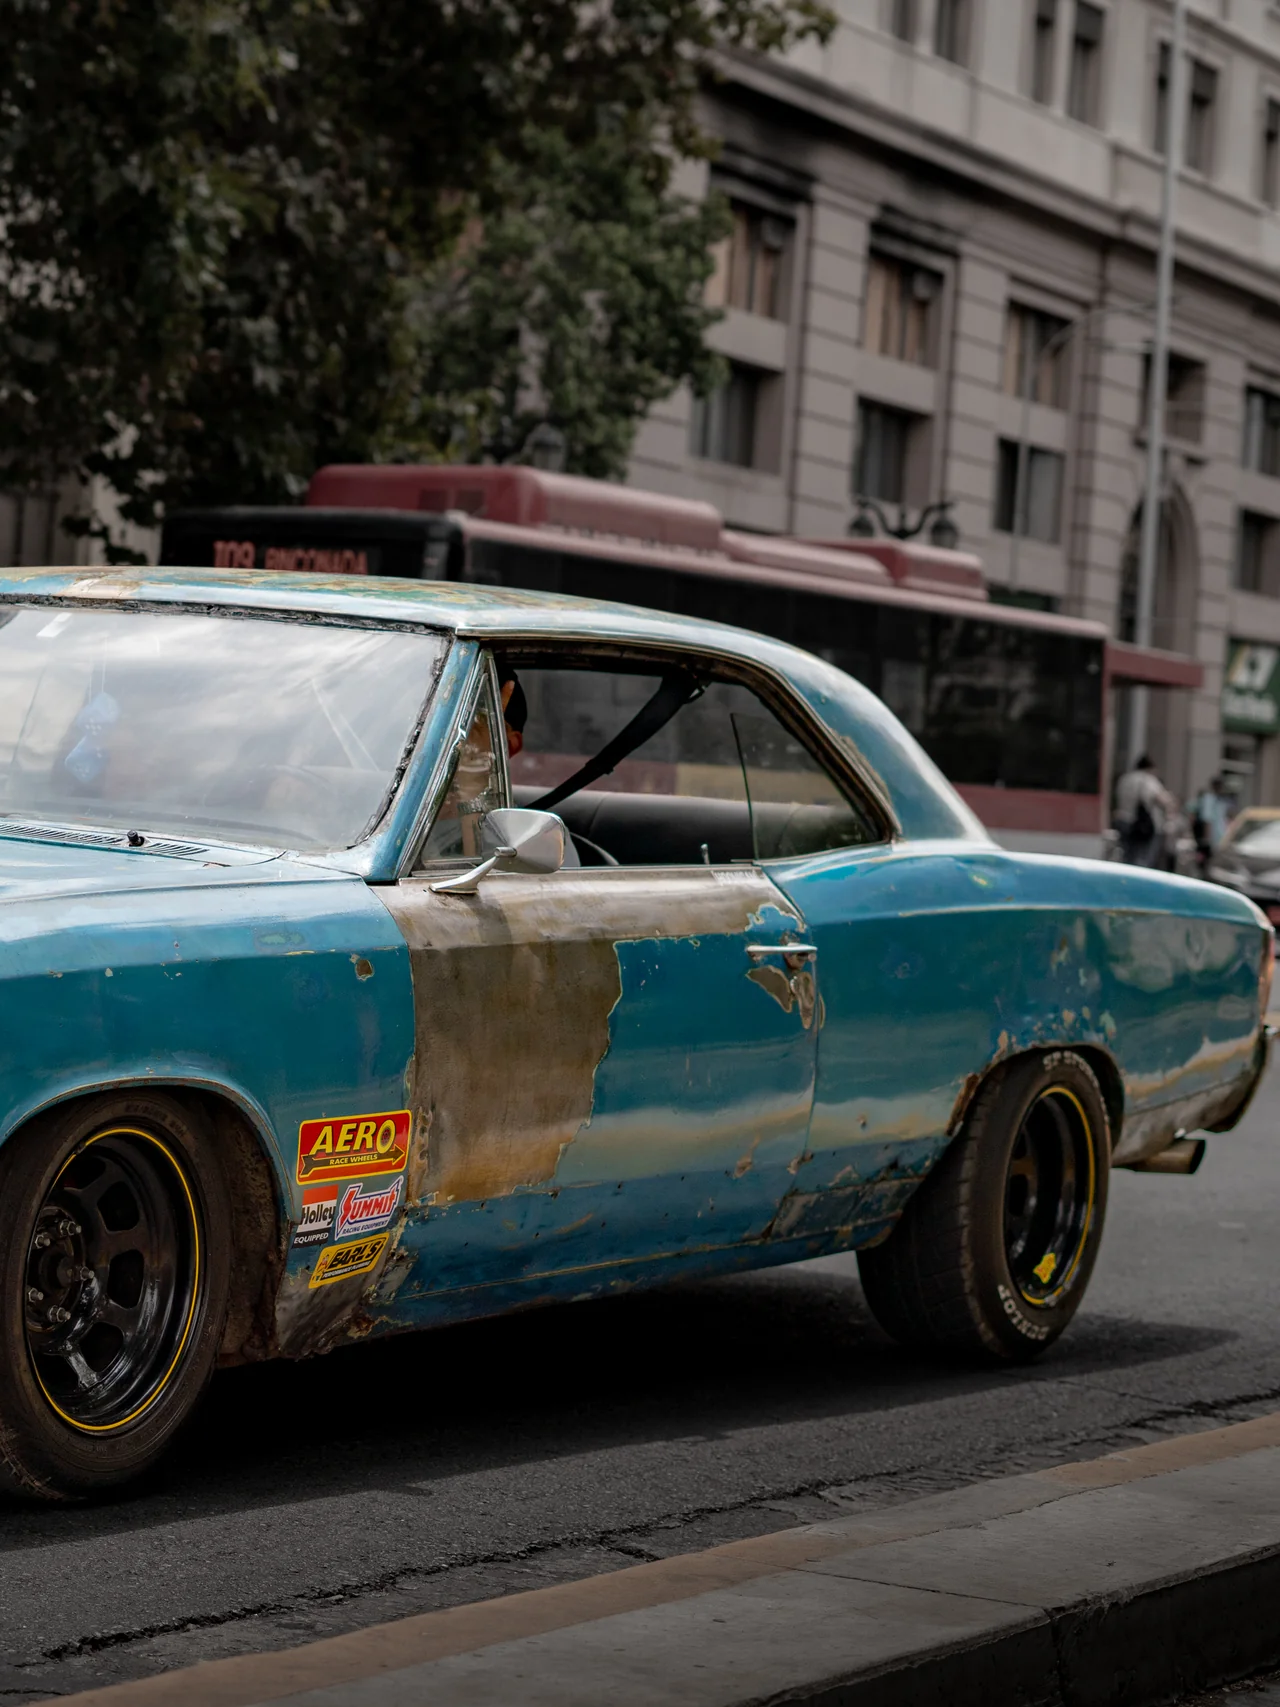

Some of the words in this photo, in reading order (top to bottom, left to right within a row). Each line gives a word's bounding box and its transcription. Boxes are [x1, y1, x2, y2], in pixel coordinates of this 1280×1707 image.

[213, 540, 255, 568] 109
[265, 546, 368, 574] RINCONADA
[308, 1119, 396, 1155] AERO
[329, 1157, 349, 1166] RACE
[350, 1154, 378, 1164] WHEELS
[300, 1204, 337, 1227] Holley
[294, 1232, 329, 1244] EQUIPPED
[342, 1226, 361, 1235] RACING
[327, 1241, 383, 1269] EARL'S
[997, 1284, 1050, 1340] DUNLOP
